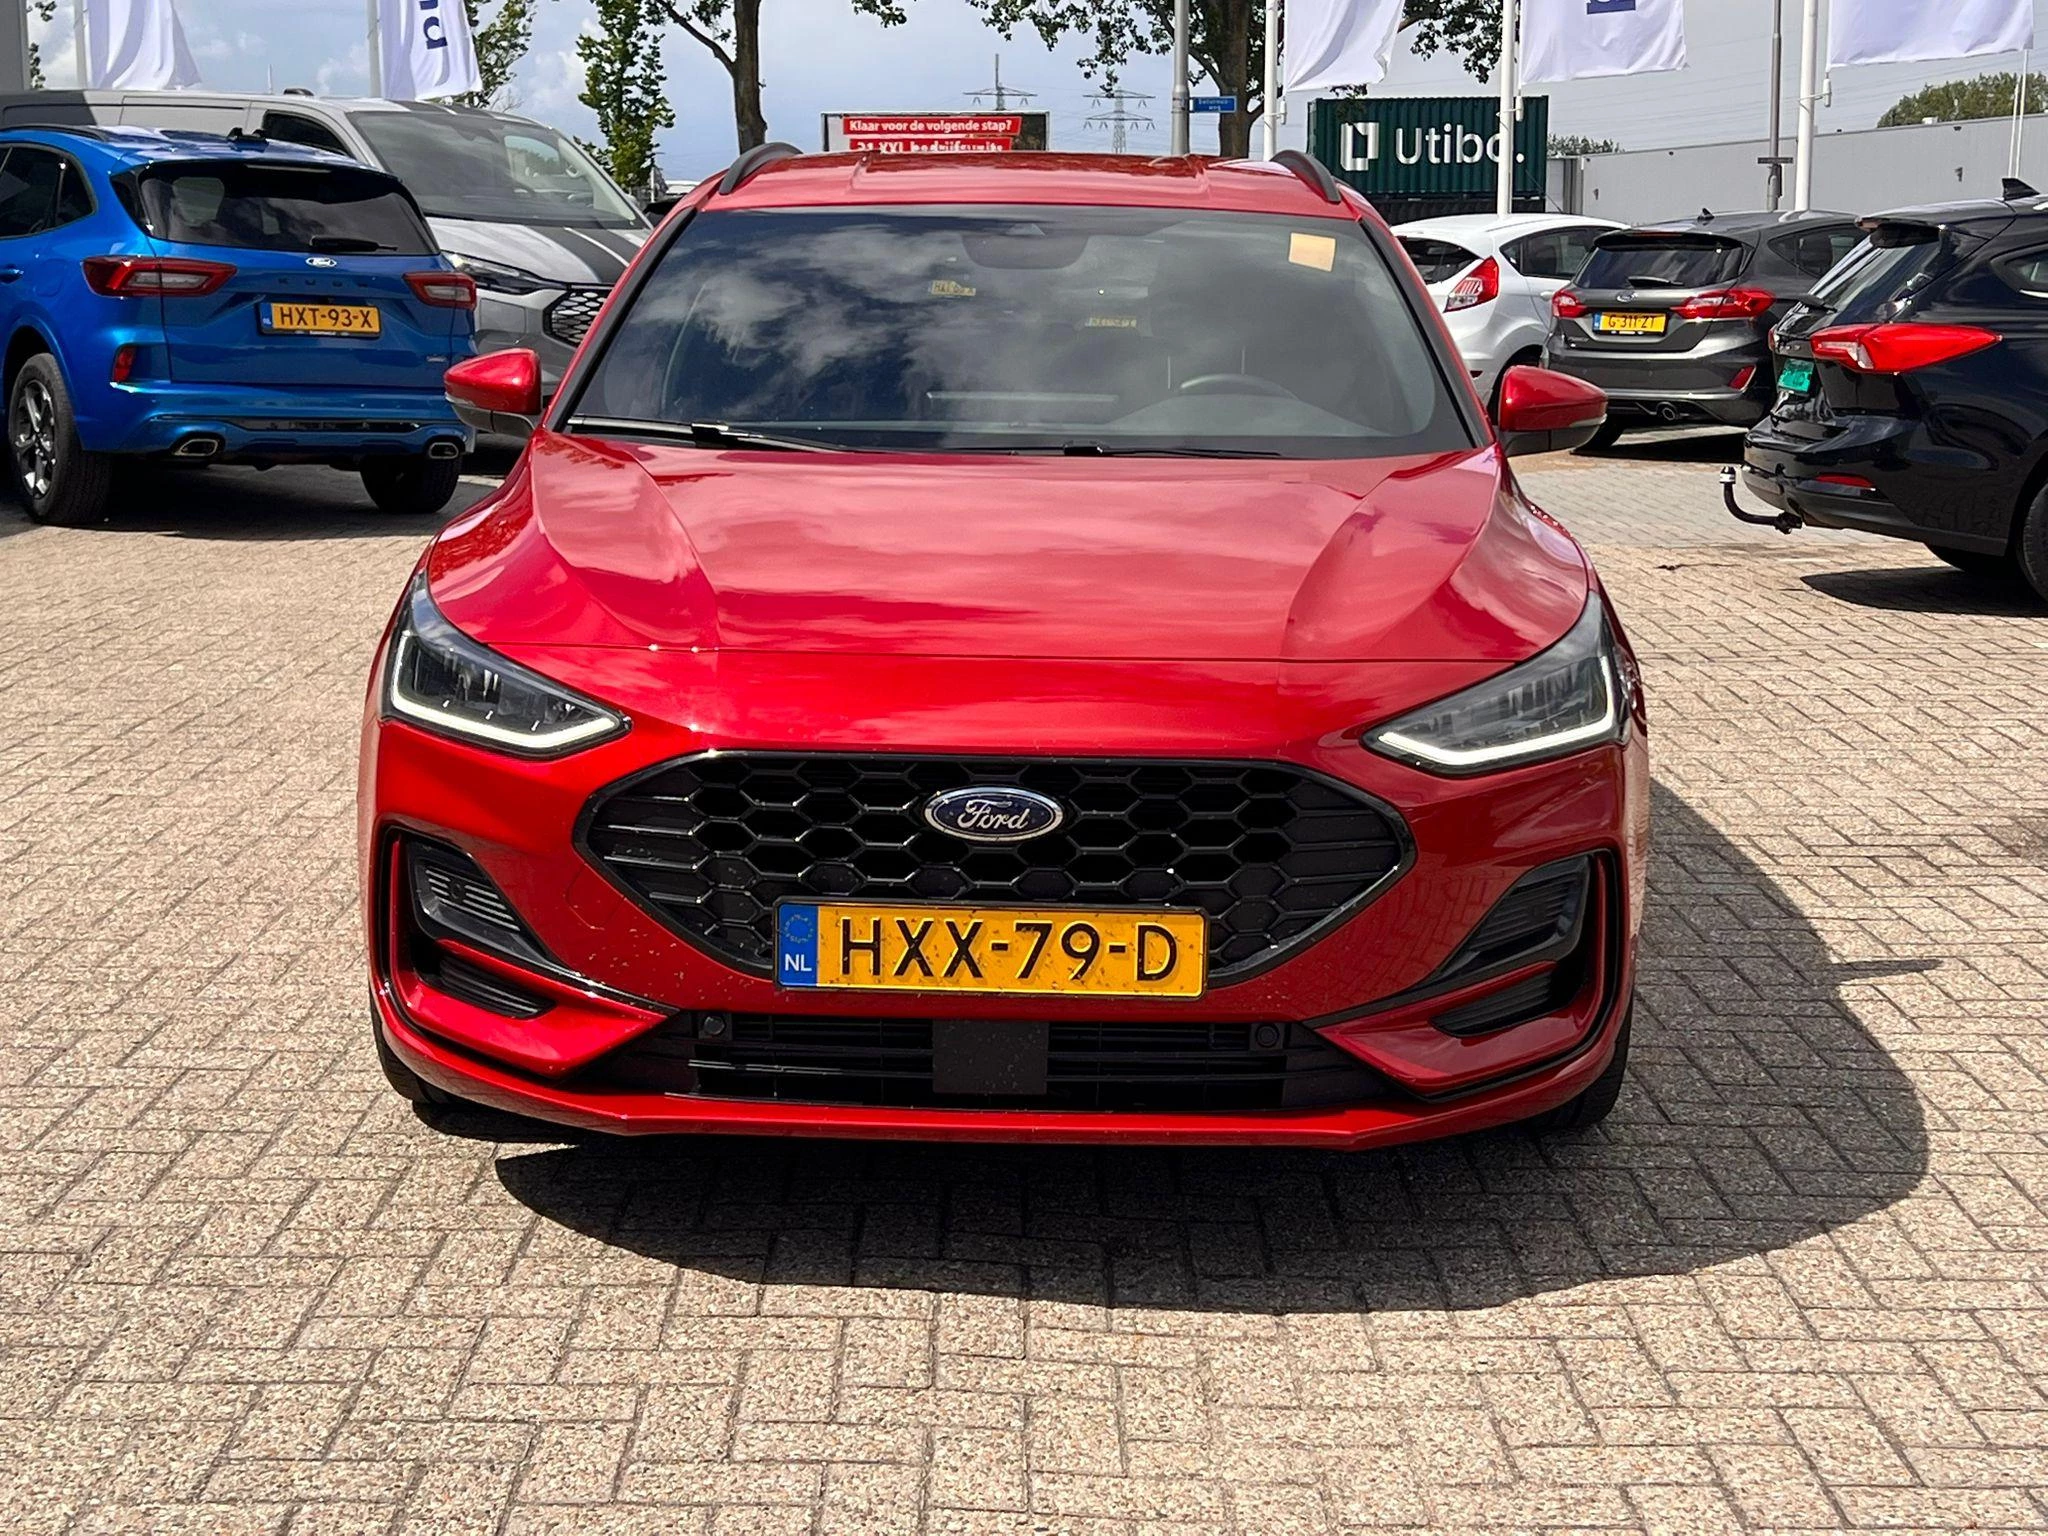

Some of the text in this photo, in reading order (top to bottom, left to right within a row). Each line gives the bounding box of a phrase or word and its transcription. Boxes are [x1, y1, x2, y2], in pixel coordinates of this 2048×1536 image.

[850, 119, 1011, 133] Klaar voor de volgende stap?
[279, 305, 373, 329] HXT-93-X
[1608, 313, 1658, 329] G-311-ZT
[957, 799, 1031, 829] Ford
[784, 917, 1178, 983] NL HXX-79-D
